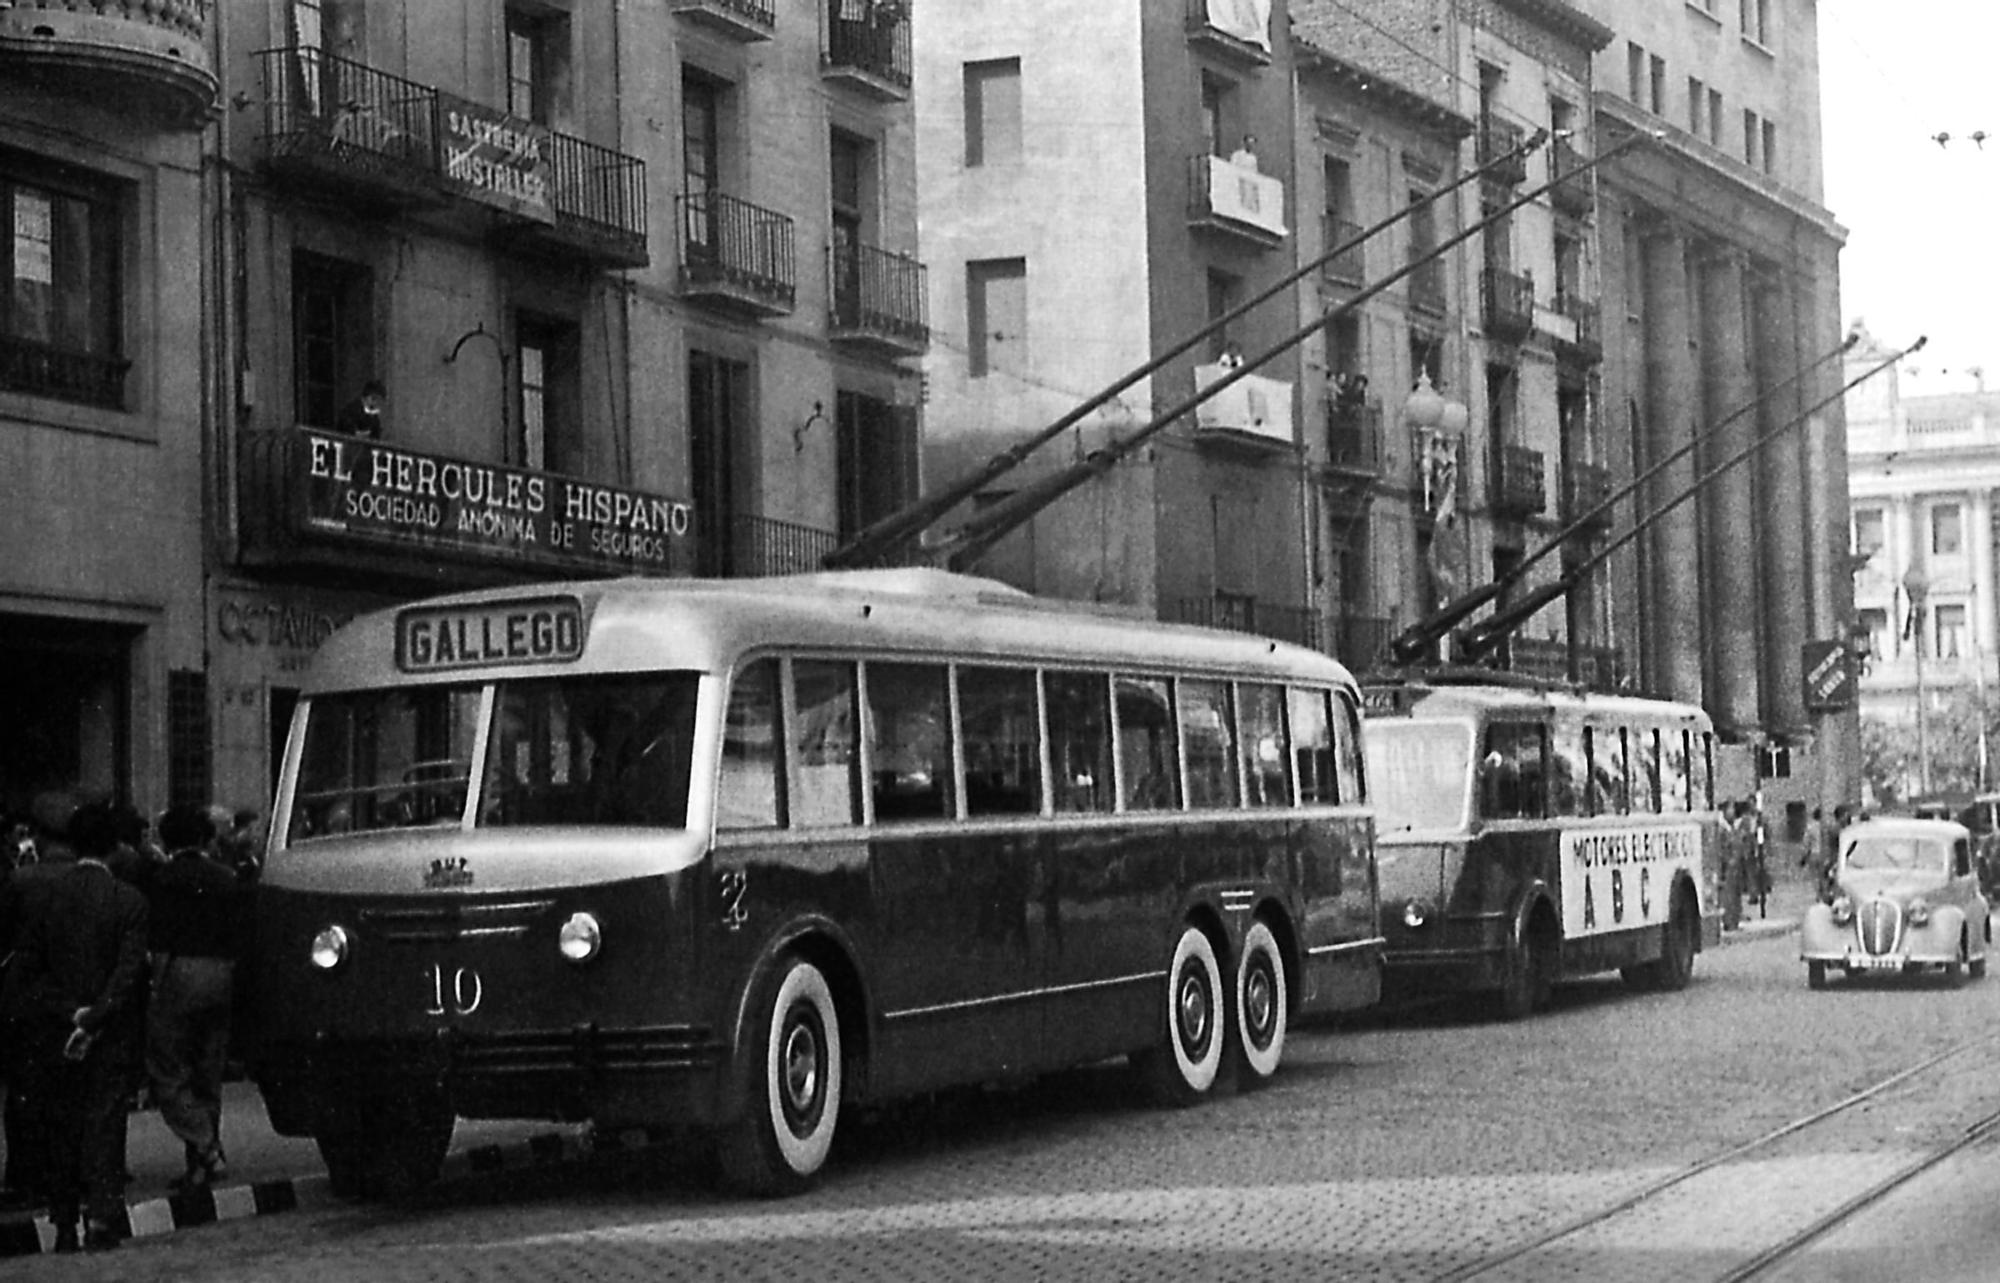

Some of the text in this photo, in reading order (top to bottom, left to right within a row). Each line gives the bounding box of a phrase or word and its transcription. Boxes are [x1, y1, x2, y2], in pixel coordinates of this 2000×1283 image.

[310, 437, 689, 537] EL HERCULES HISPANO
[346, 490, 441, 528] SOCIEDAD
[551, 520, 573, 547] DE
[591, 531, 664, 561] SEGUROS
[411, 612, 578, 664] GALLEGO
[1573, 835, 1626, 868] MOTORES
[424, 963, 482, 1014] 10
